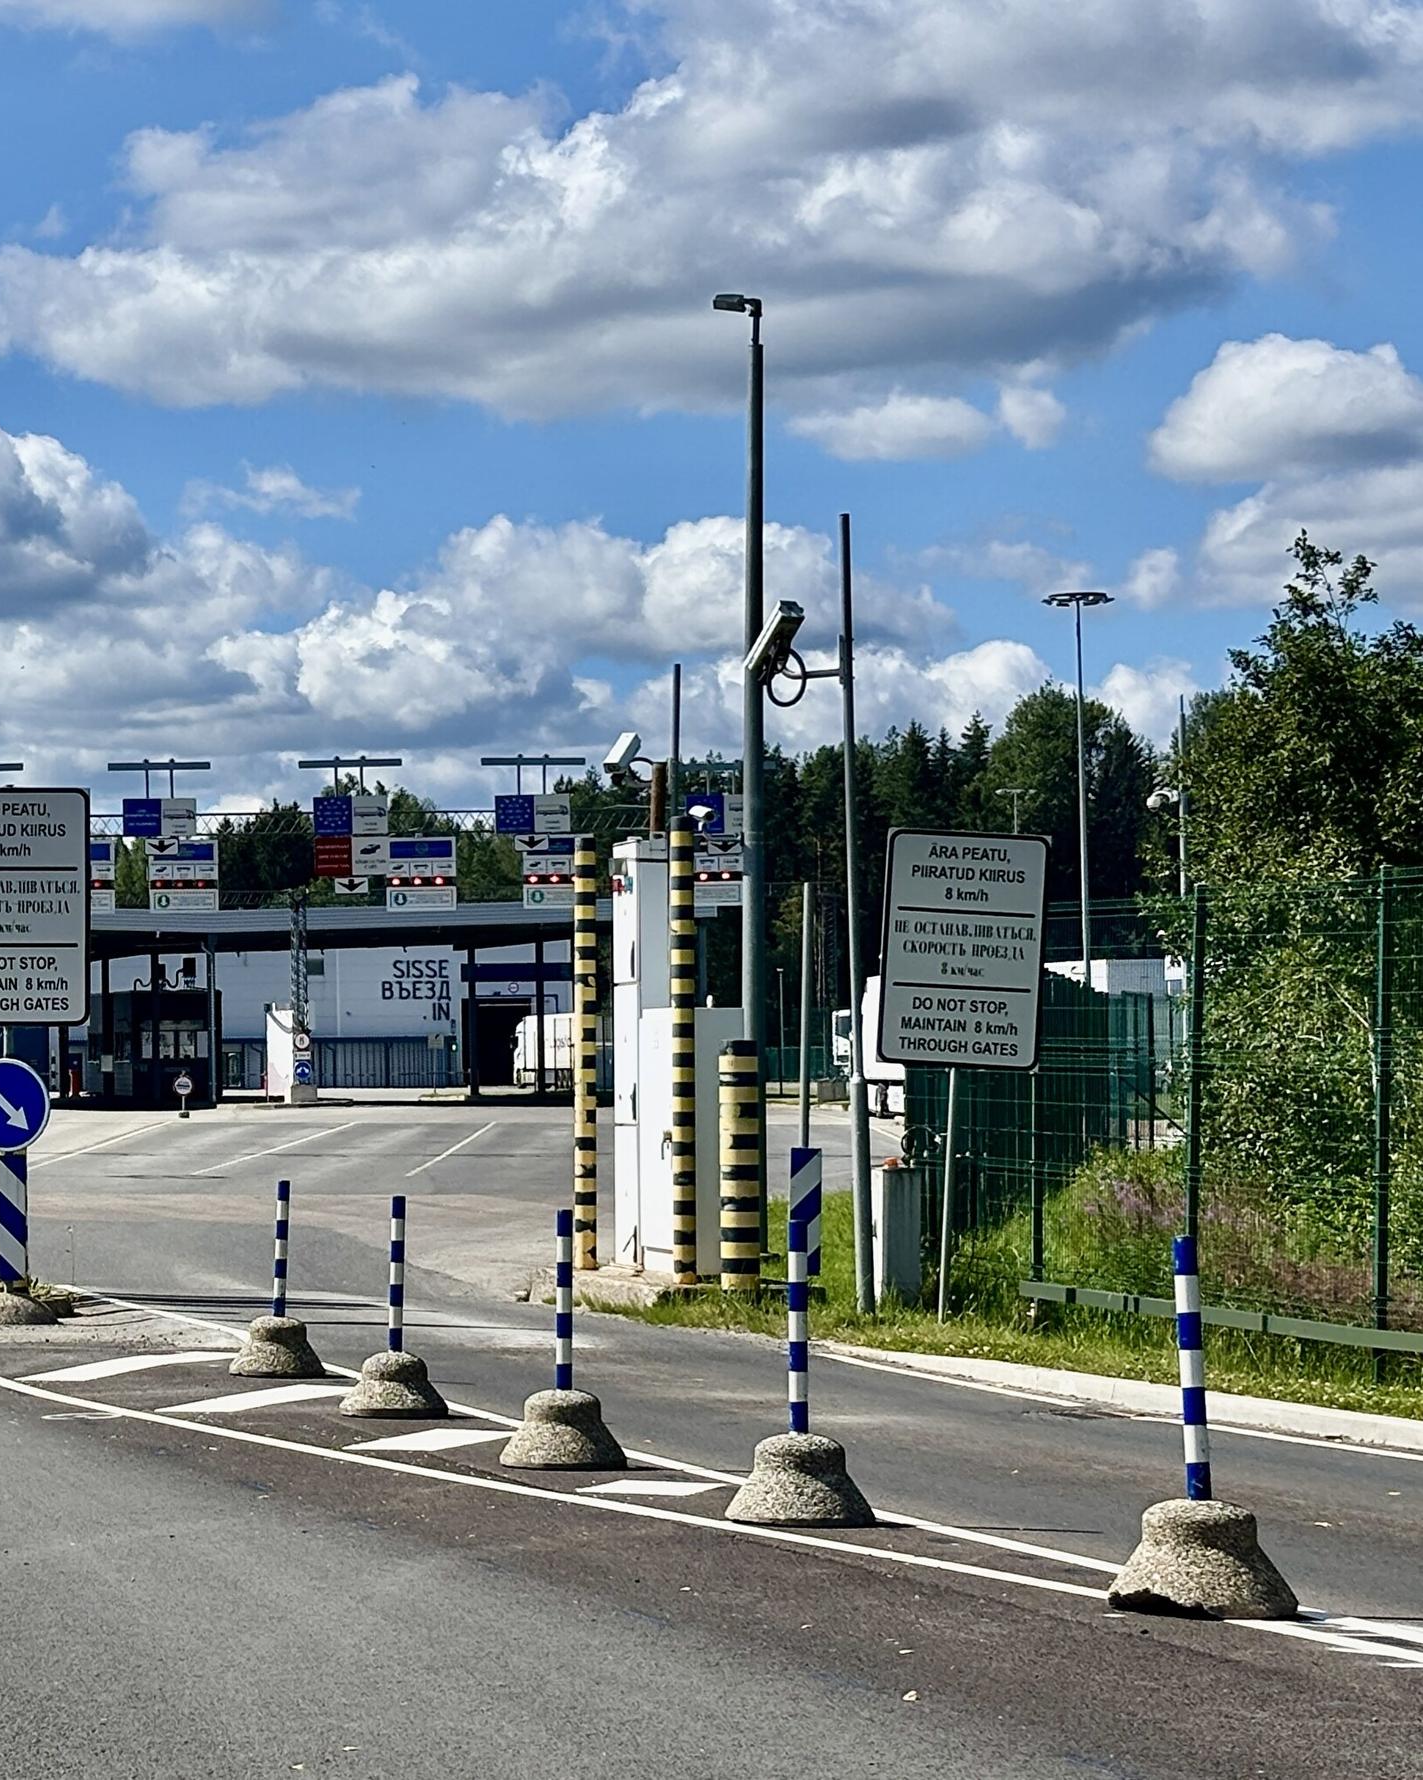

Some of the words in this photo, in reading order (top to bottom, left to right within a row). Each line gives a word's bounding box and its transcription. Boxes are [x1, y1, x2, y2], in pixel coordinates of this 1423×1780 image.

[2, 803, 51, 819] PEATU,
[20, 823, 67, 838] KIIRUS
[0, 843, 32, 857] km/h
[928, 842, 958, 859] ÄRA
[961, 847, 1011, 864] PEATU,
[911, 864, 976, 881] PIIRATUD
[978, 868, 1026, 884] KIIRUS
[944, 887, 953, 900] 8
[957, 888, 989, 902] km/h
[17, 899, 70, 915] ПРОЕЗДА
[894, 920, 910, 934] НЕ
[903, 940, 966, 956] СКОРОСТЬ
[972, 943, 1025, 961] ПРОЕЗДА
[19, 957, 58, 972] STOP,
[392, 959, 449, 978] SISSE
[940, 962, 948, 975] 8
[25, 977, 34, 991] 8
[36, 977, 68, 991] km/h
[382, 981, 451, 1002] ВЪЕЗД
[23, 997, 70, 1012] GATES
[432, 1002, 451, 1021] IN
[912, 996, 934, 1010] DO
[936, 998, 967, 1012] NOT
[969, 1000, 1009, 1016] STOP,
[900, 1016, 967, 1033] MAINTAIN
[974, 1020, 982, 1034] 8
[986, 1021, 1018, 1036] km/h
[899, 1036, 968, 1054] THROUGH
[972, 1041, 1019, 1057] GATES
